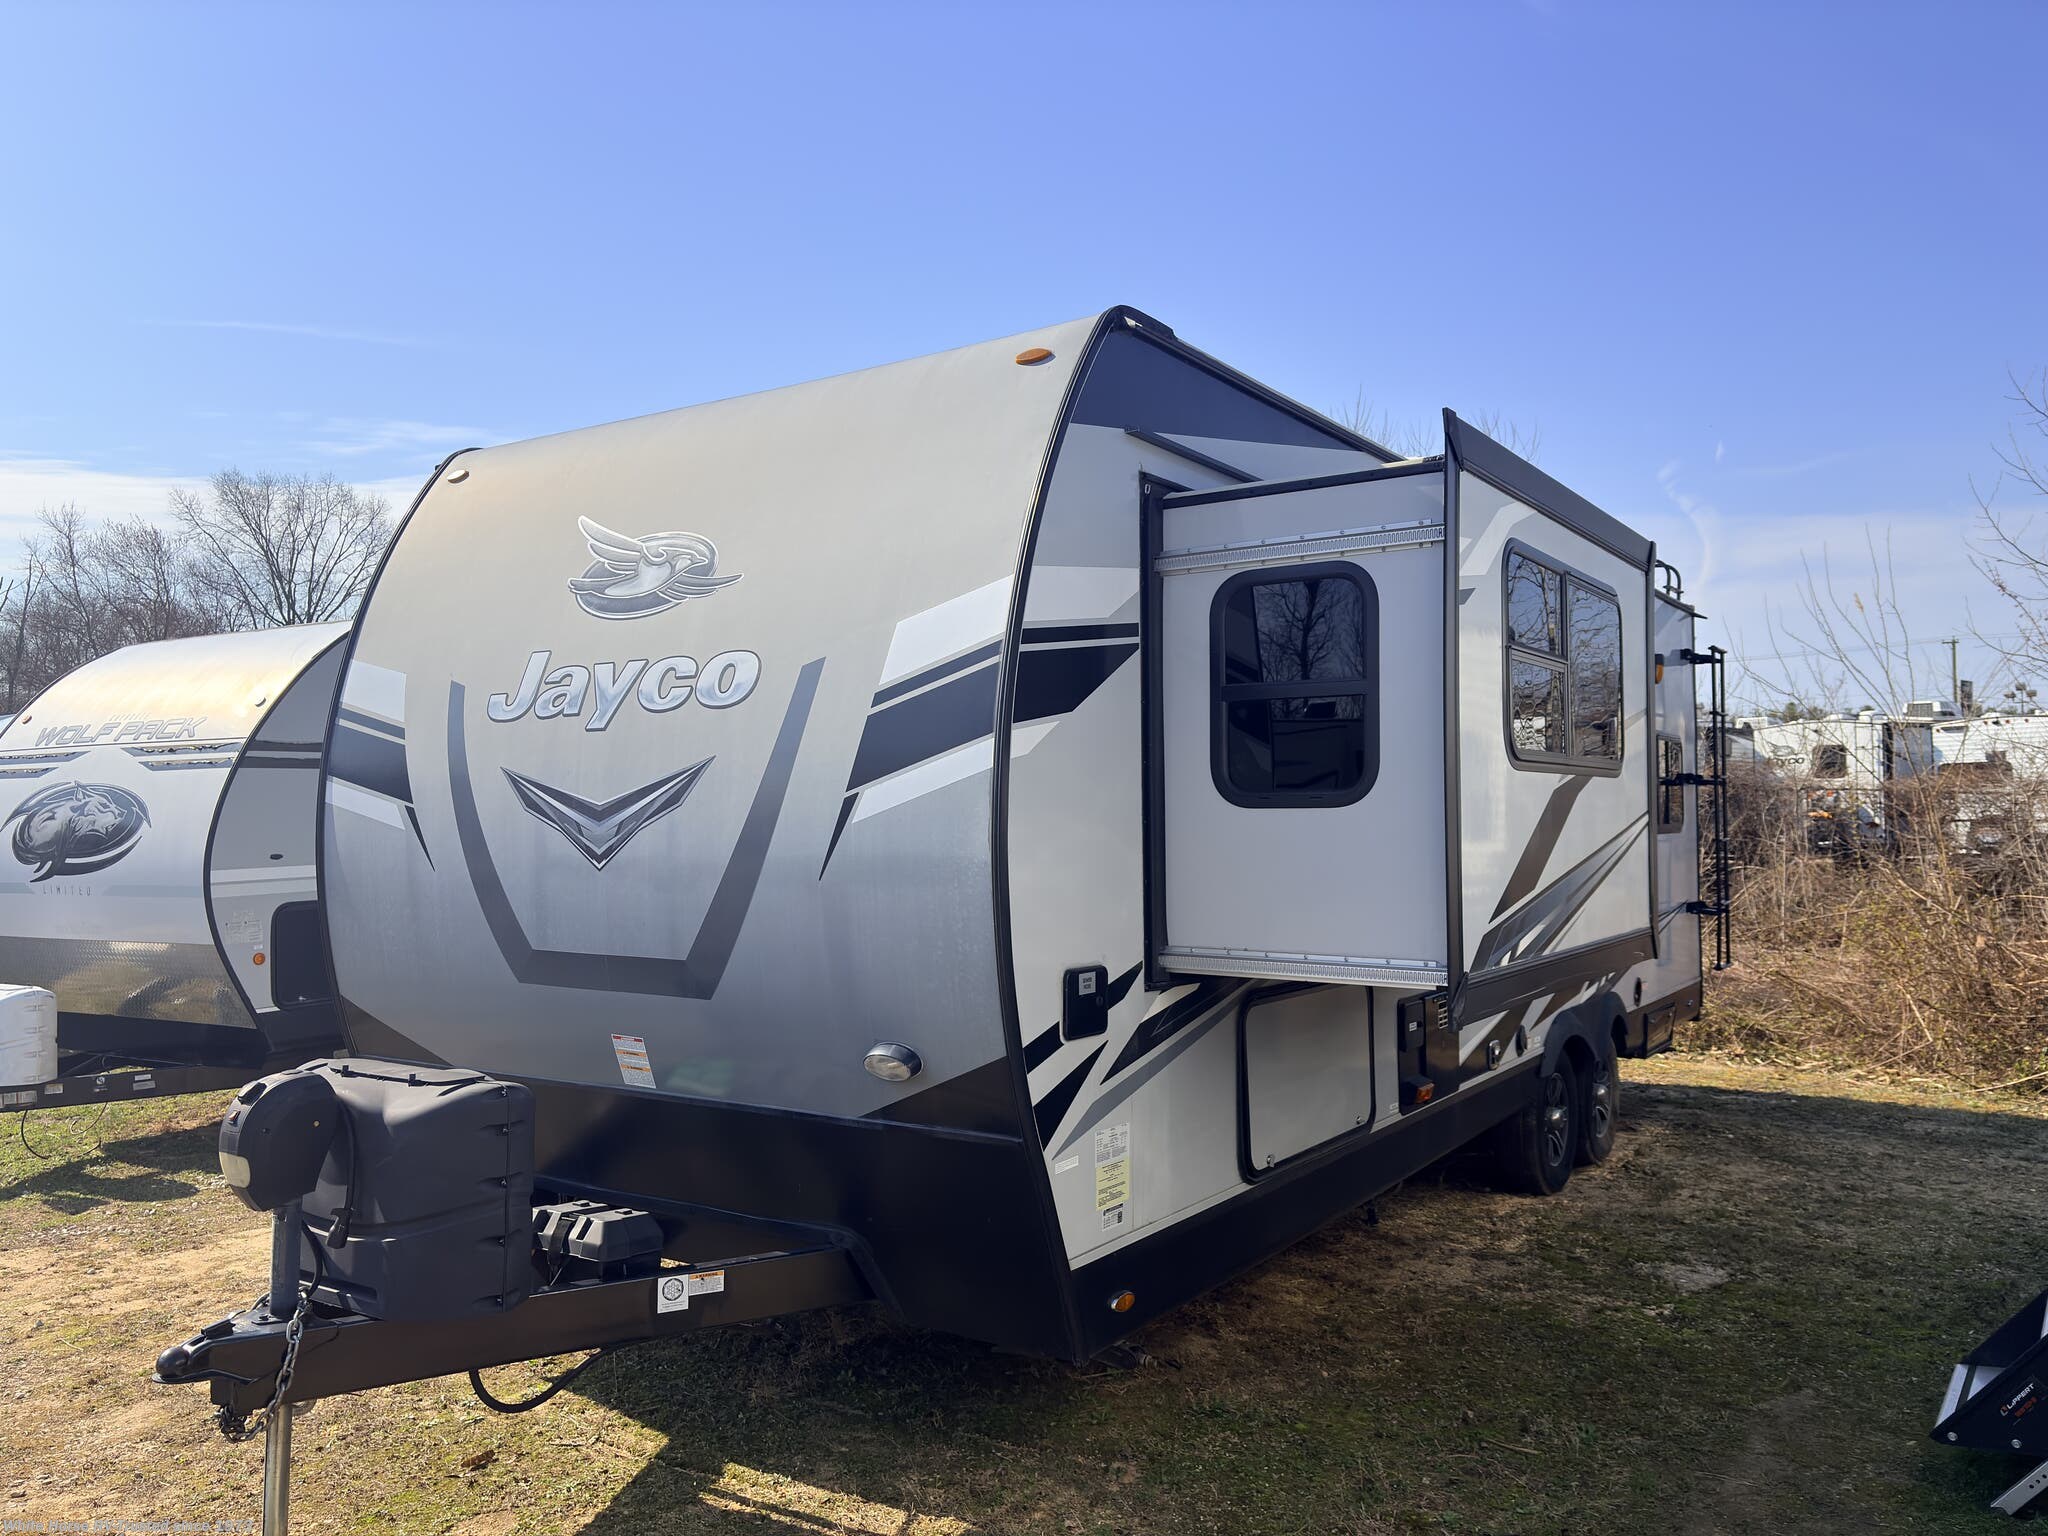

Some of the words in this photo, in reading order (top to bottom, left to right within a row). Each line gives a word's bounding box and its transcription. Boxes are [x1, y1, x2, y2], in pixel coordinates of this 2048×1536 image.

[487, 650, 761, 732] Jayco
[35, 721, 120, 747] WOLF
[113, 716, 208, 742] PACK
[2006, 1383, 2034, 1409] LIPPERT
